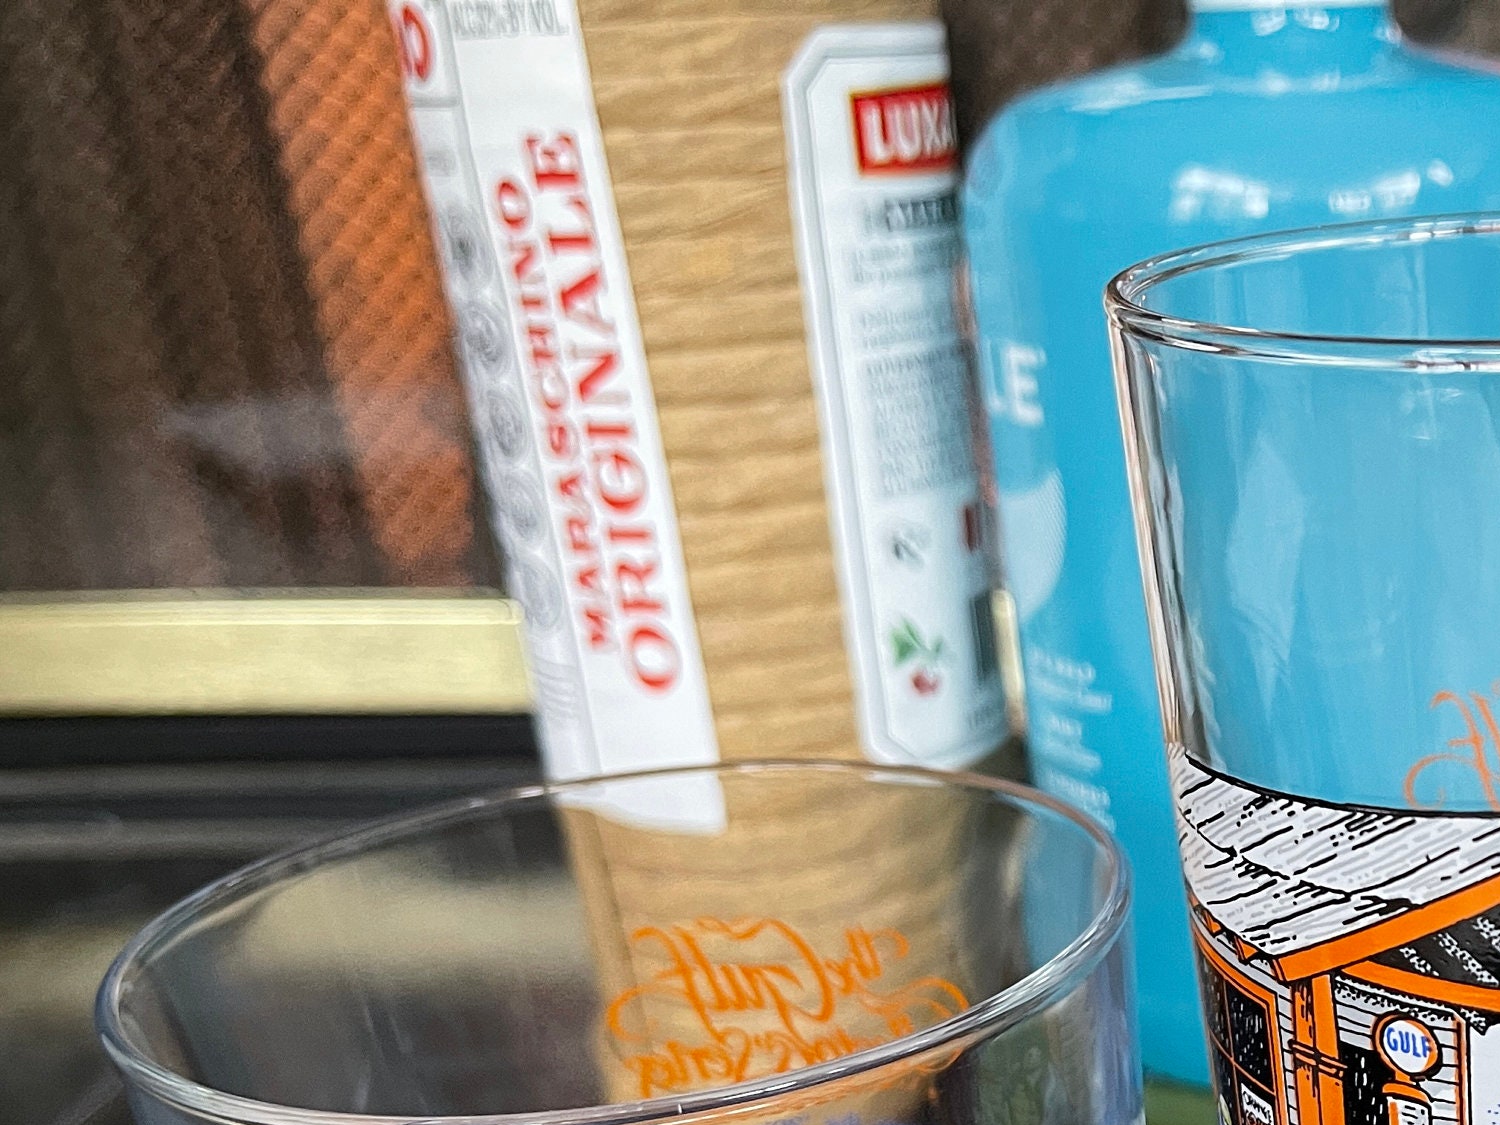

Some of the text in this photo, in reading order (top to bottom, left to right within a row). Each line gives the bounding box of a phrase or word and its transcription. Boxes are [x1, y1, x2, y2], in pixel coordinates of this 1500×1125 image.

[497, 177, 620, 654] MARASCHINO
[525, 130, 684, 695] ORIGINALE
[1385, 1025, 1432, 1059] GULF
